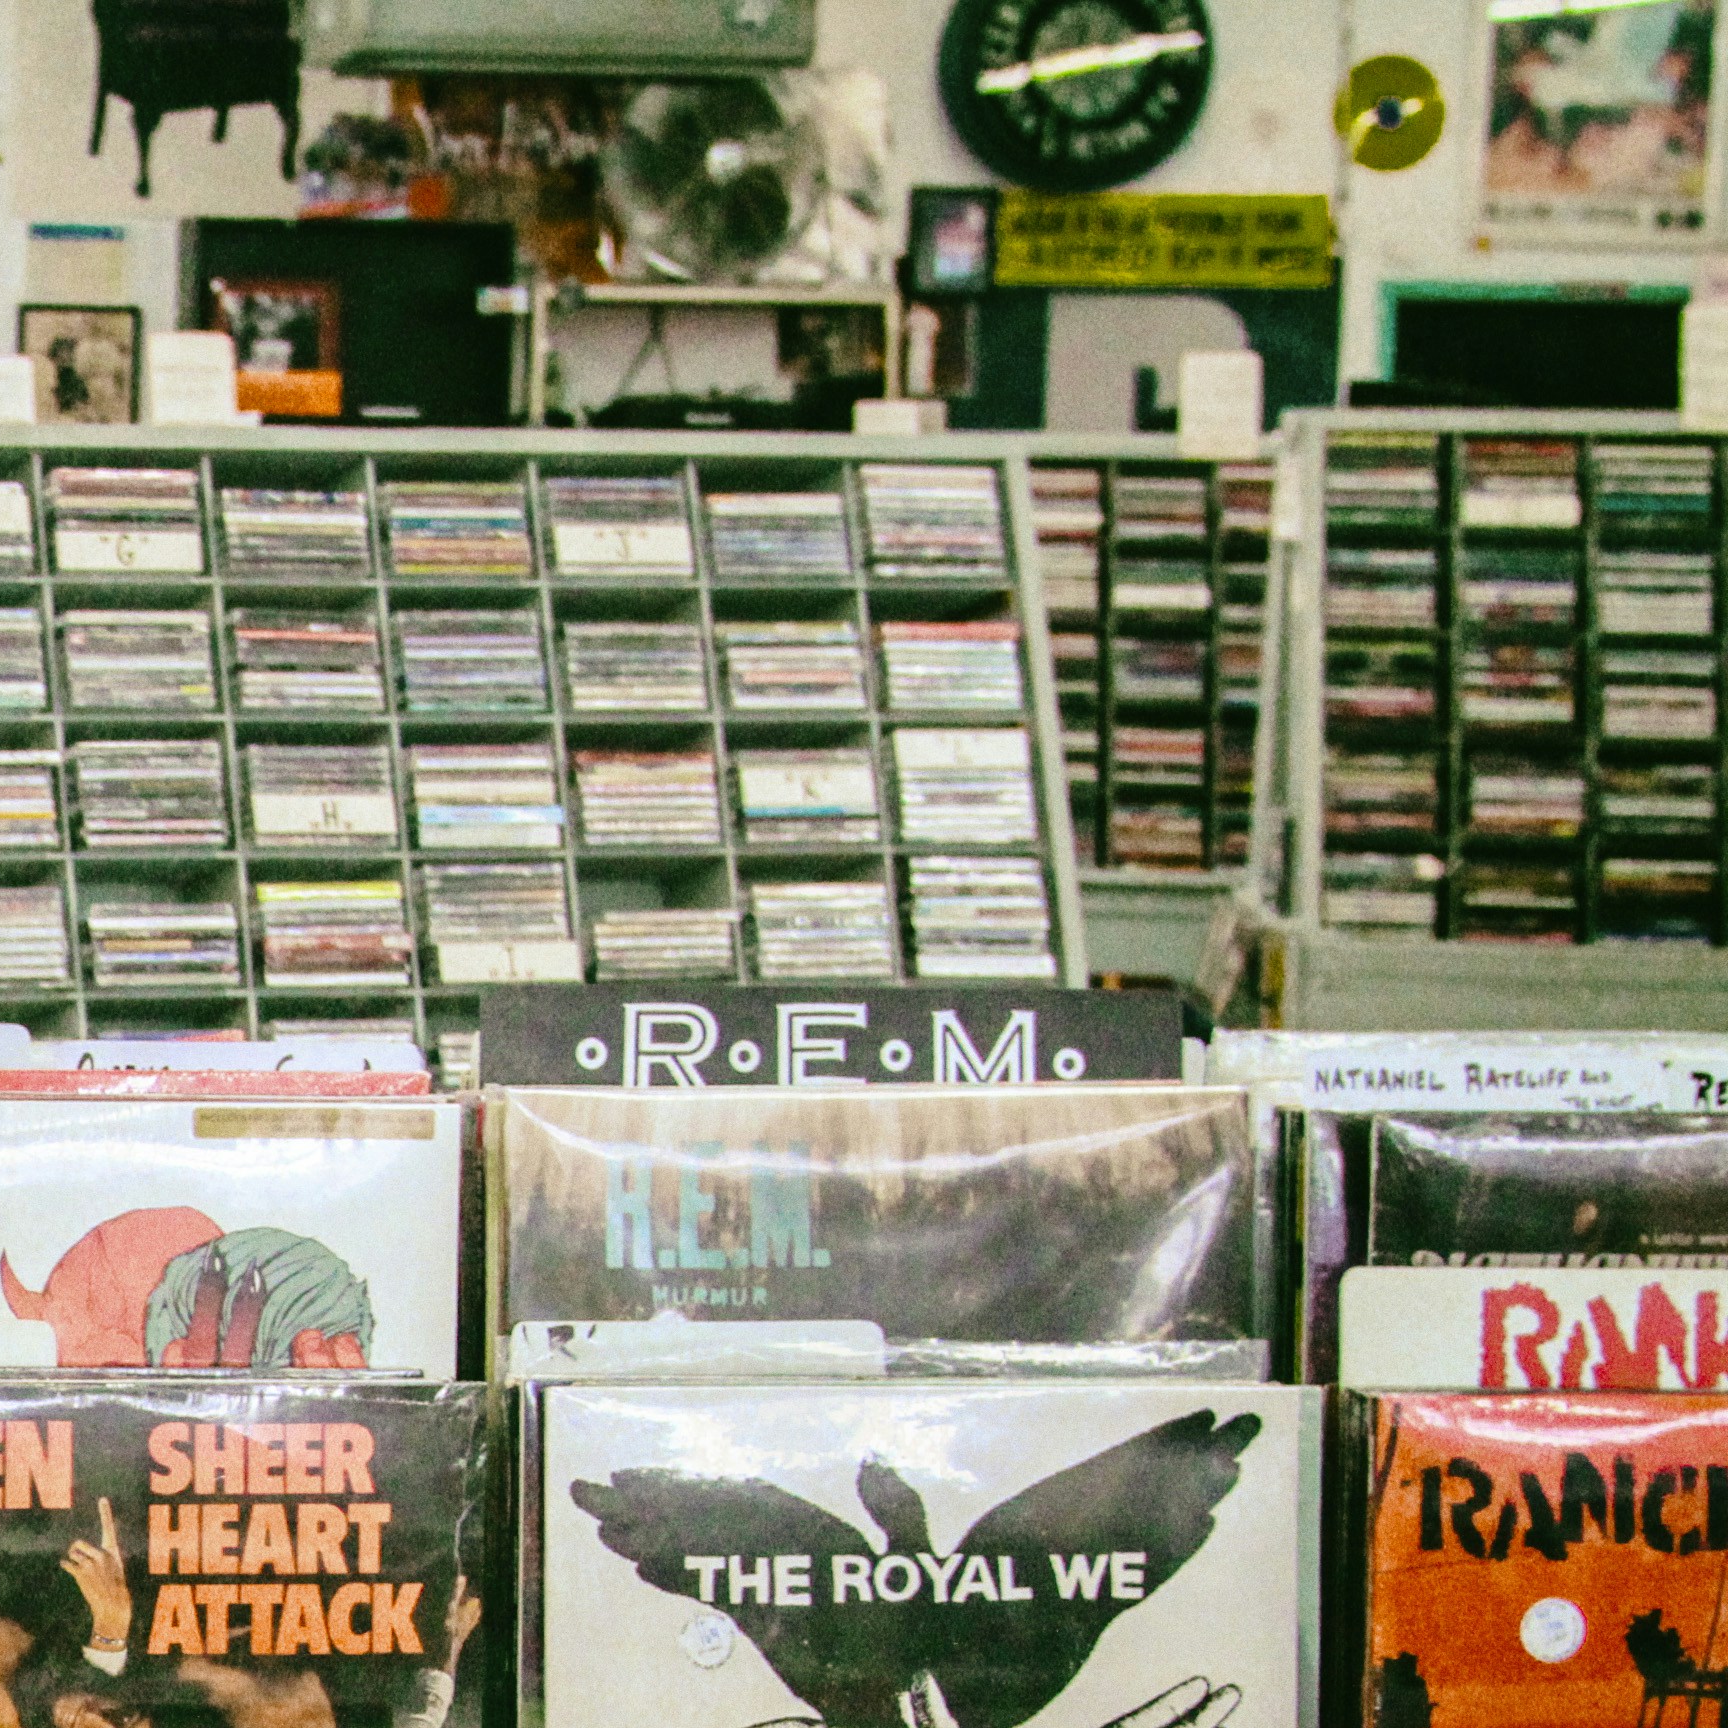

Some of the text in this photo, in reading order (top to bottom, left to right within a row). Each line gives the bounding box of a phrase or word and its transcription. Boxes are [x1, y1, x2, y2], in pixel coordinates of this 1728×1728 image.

[1314, 1067, 1444, 1093] NATHANIEL
[1690, 1072, 1728, 1108] RE
[652, 1286, 767, 1306] MURMUR
[148, 1422, 376, 1497] SHEER
[148, 1501, 393, 1576] HEART
[683, 1550, 1146, 1606] THE ROYAL WE
[146, 1582, 424, 1657] ATTACK
